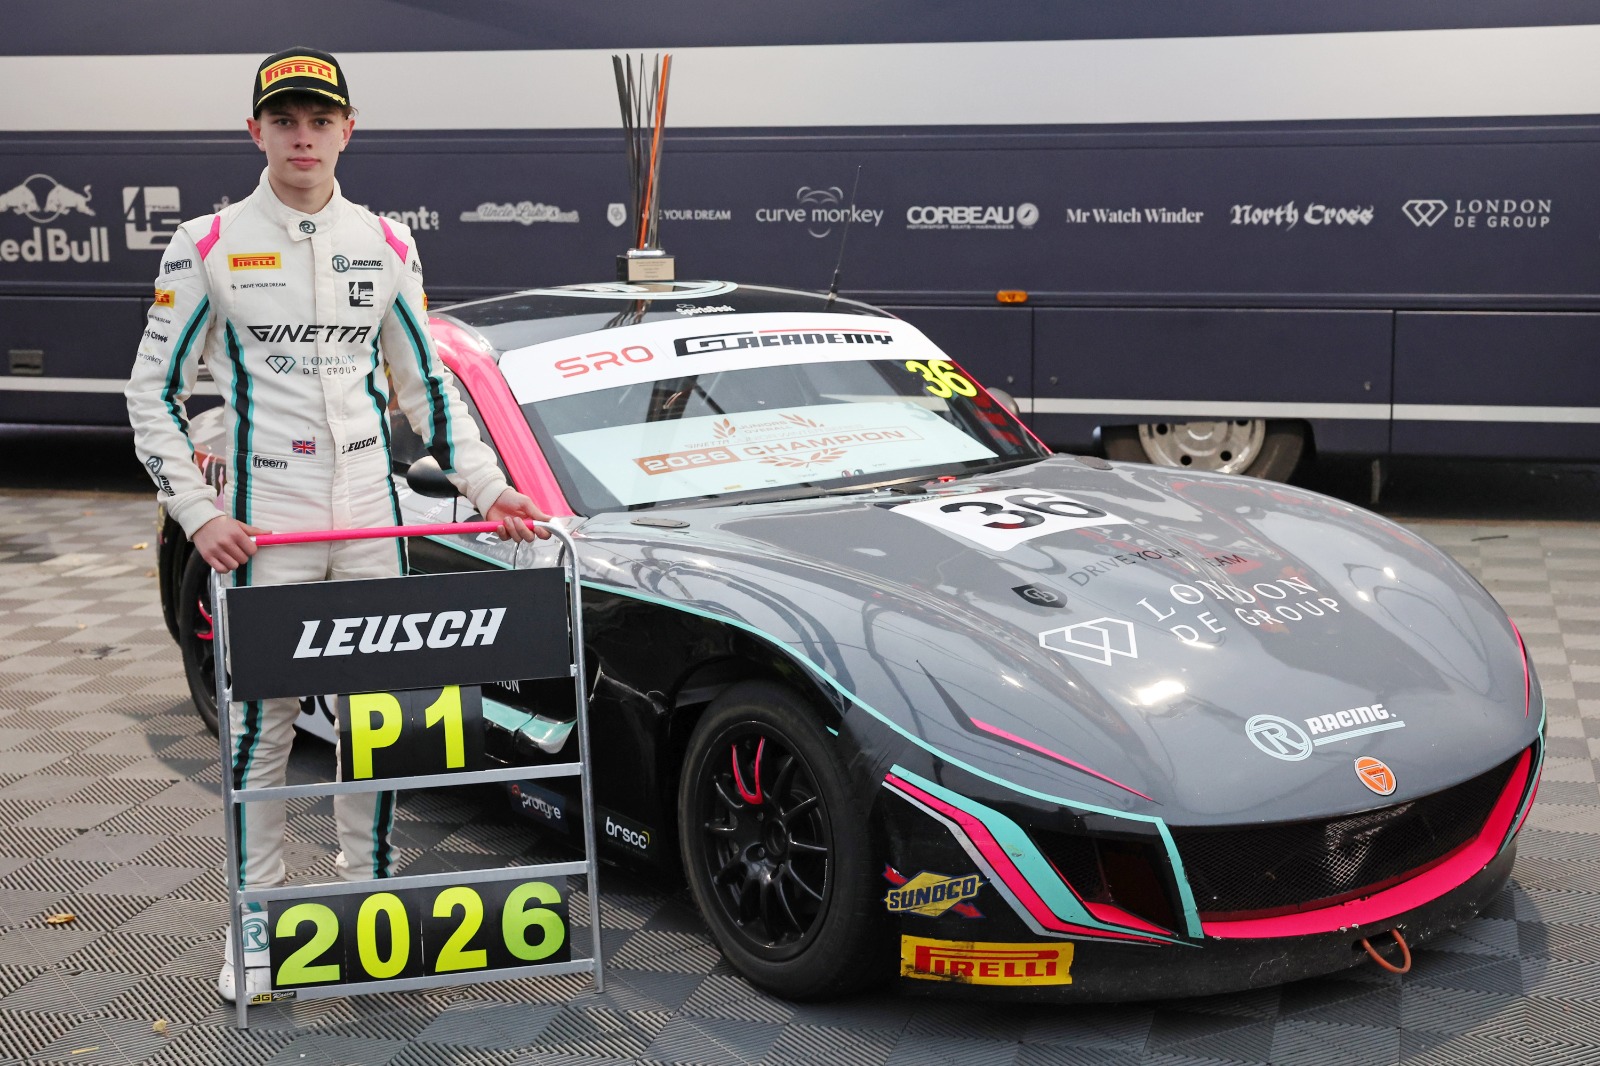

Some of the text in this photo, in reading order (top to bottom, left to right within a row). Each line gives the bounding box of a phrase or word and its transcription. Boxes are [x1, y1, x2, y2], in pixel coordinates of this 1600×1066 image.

[265, 60, 332, 84] PIRELLI
[664, 209, 693, 220] YOUR
[694, 209, 731, 220] DREAM
[756, 206, 884, 227] curve monkey
[907, 206, 1014, 224] CORBEAU
[1066, 207, 1204, 223] Mr Watch Winder
[1230, 200, 1374, 231] North Cross
[1454, 215, 1550, 228] DE GROUP
[1455, 200, 1552, 213] LONDON
[0, 227, 110, 263] ed Bull
[233, 256, 275, 268] PIRELLI
[247, 325, 372, 343] GINETTA
[327, 366, 357, 375] GROUP
[554, 345, 654, 379] SRO
[906, 359, 979, 399] 36
[252, 455, 287, 469] freem
[643, 429, 906, 471] 2026 CHAMPION
[939, 494, 1107, 530] 36
[1068, 554, 1136, 587] DRIVE
[1136, 576, 1319, 622] LONDON
[293, 607, 507, 659] LEUSCH
[1170, 597, 1341, 645] DE GROUP
[605, 816, 648, 849] brscc
[889, 877, 976, 909] SUNOCO
[275, 881, 565, 986] 2026
[915, 945, 1060, 978] PIRELLI
